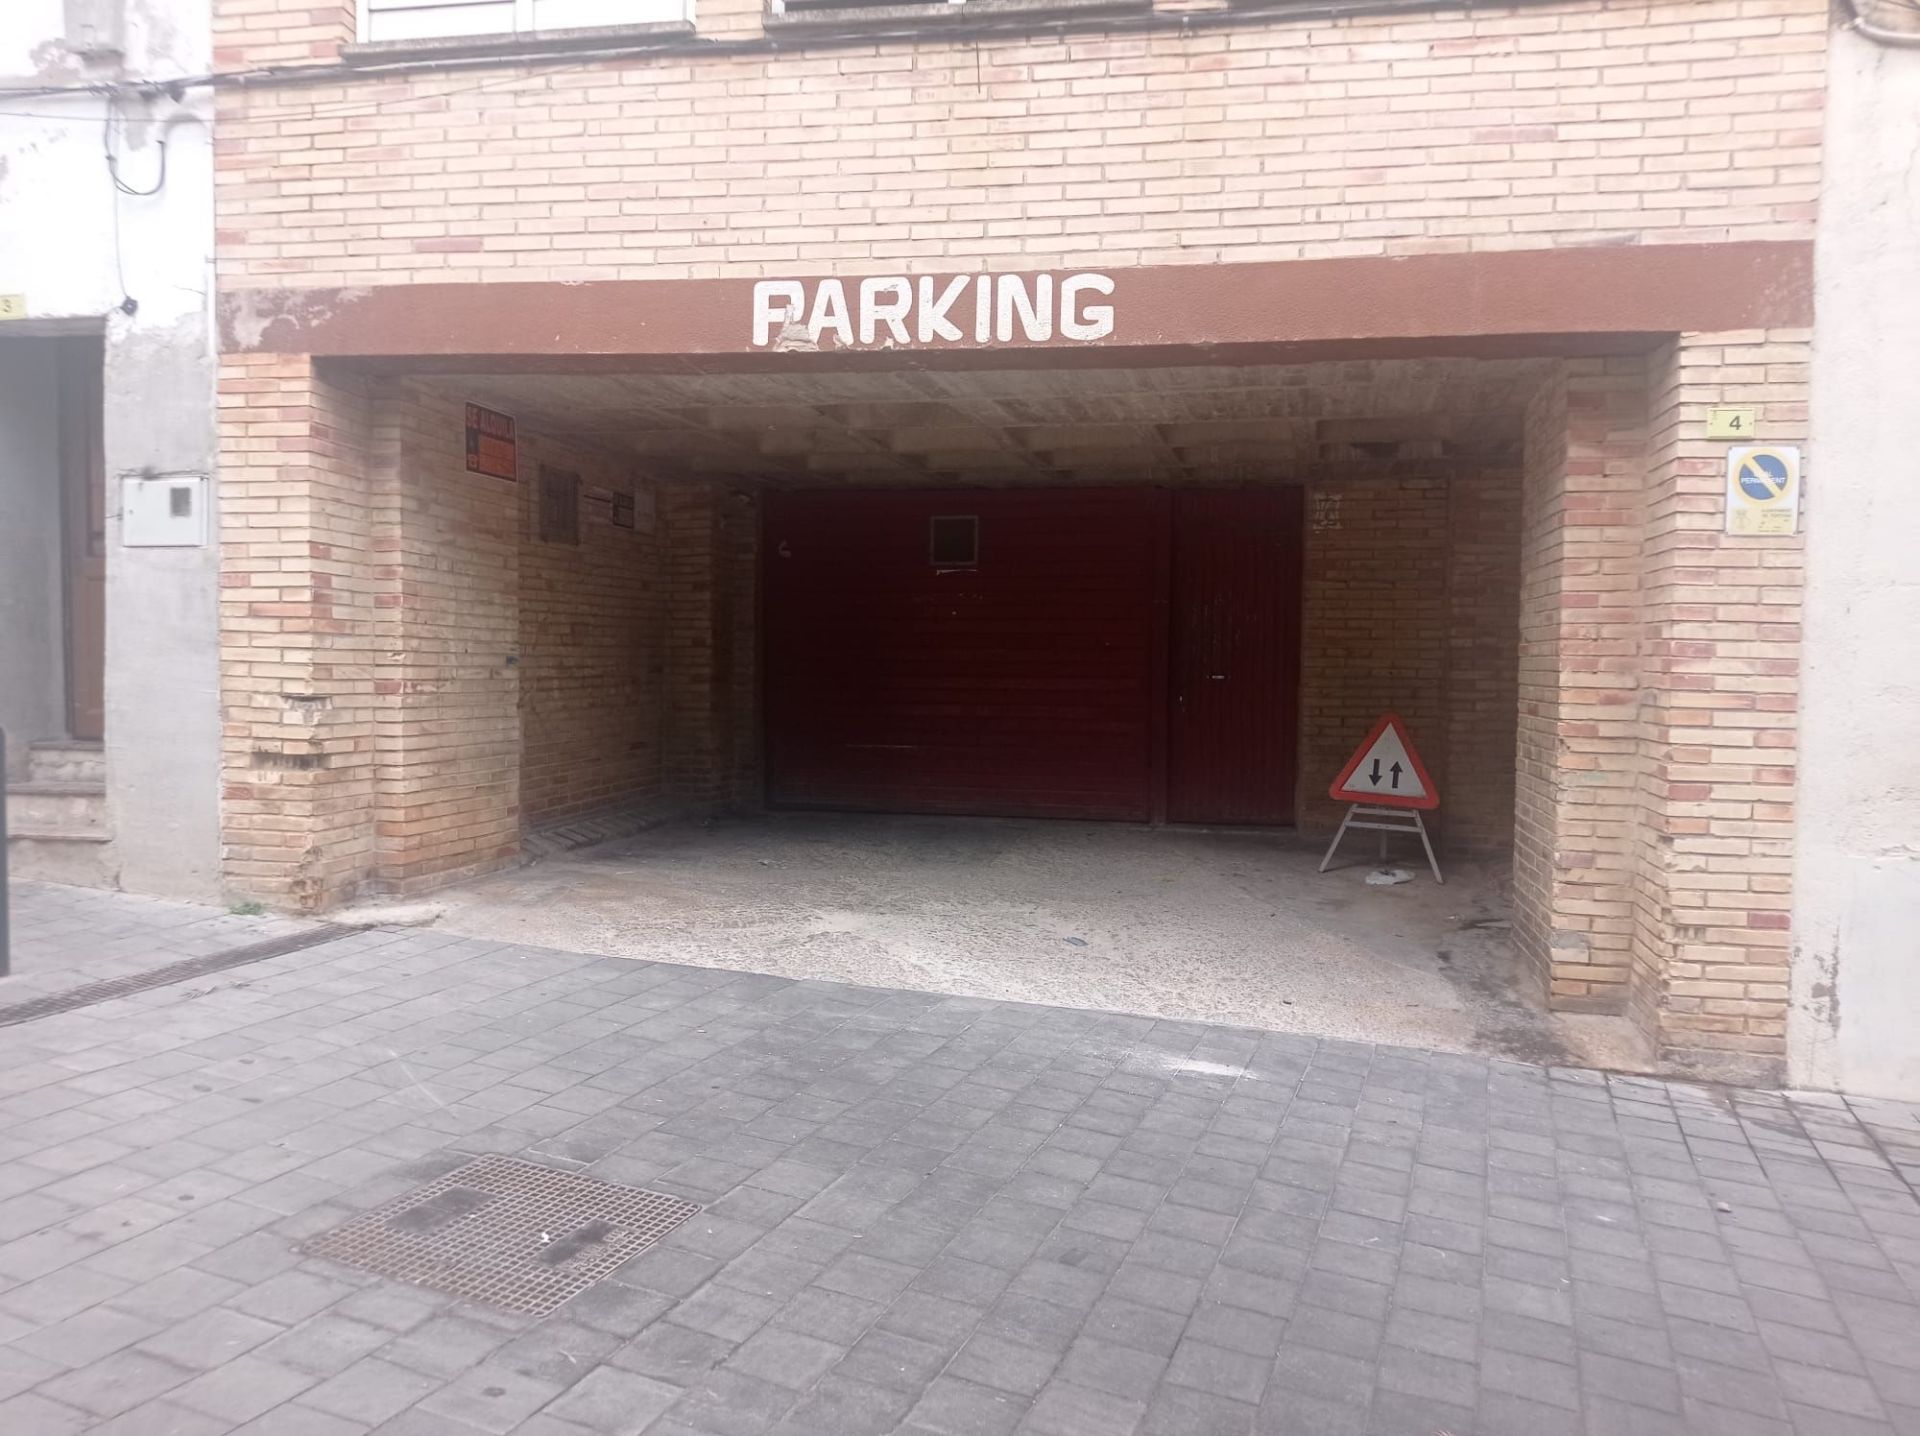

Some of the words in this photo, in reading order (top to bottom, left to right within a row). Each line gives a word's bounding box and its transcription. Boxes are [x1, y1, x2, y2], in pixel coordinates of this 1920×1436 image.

[752, 273, 1115, 347] PARKING
[1729, 415, 1742, 431] 4
[1740, 477, 1786, 485] PERMENT
